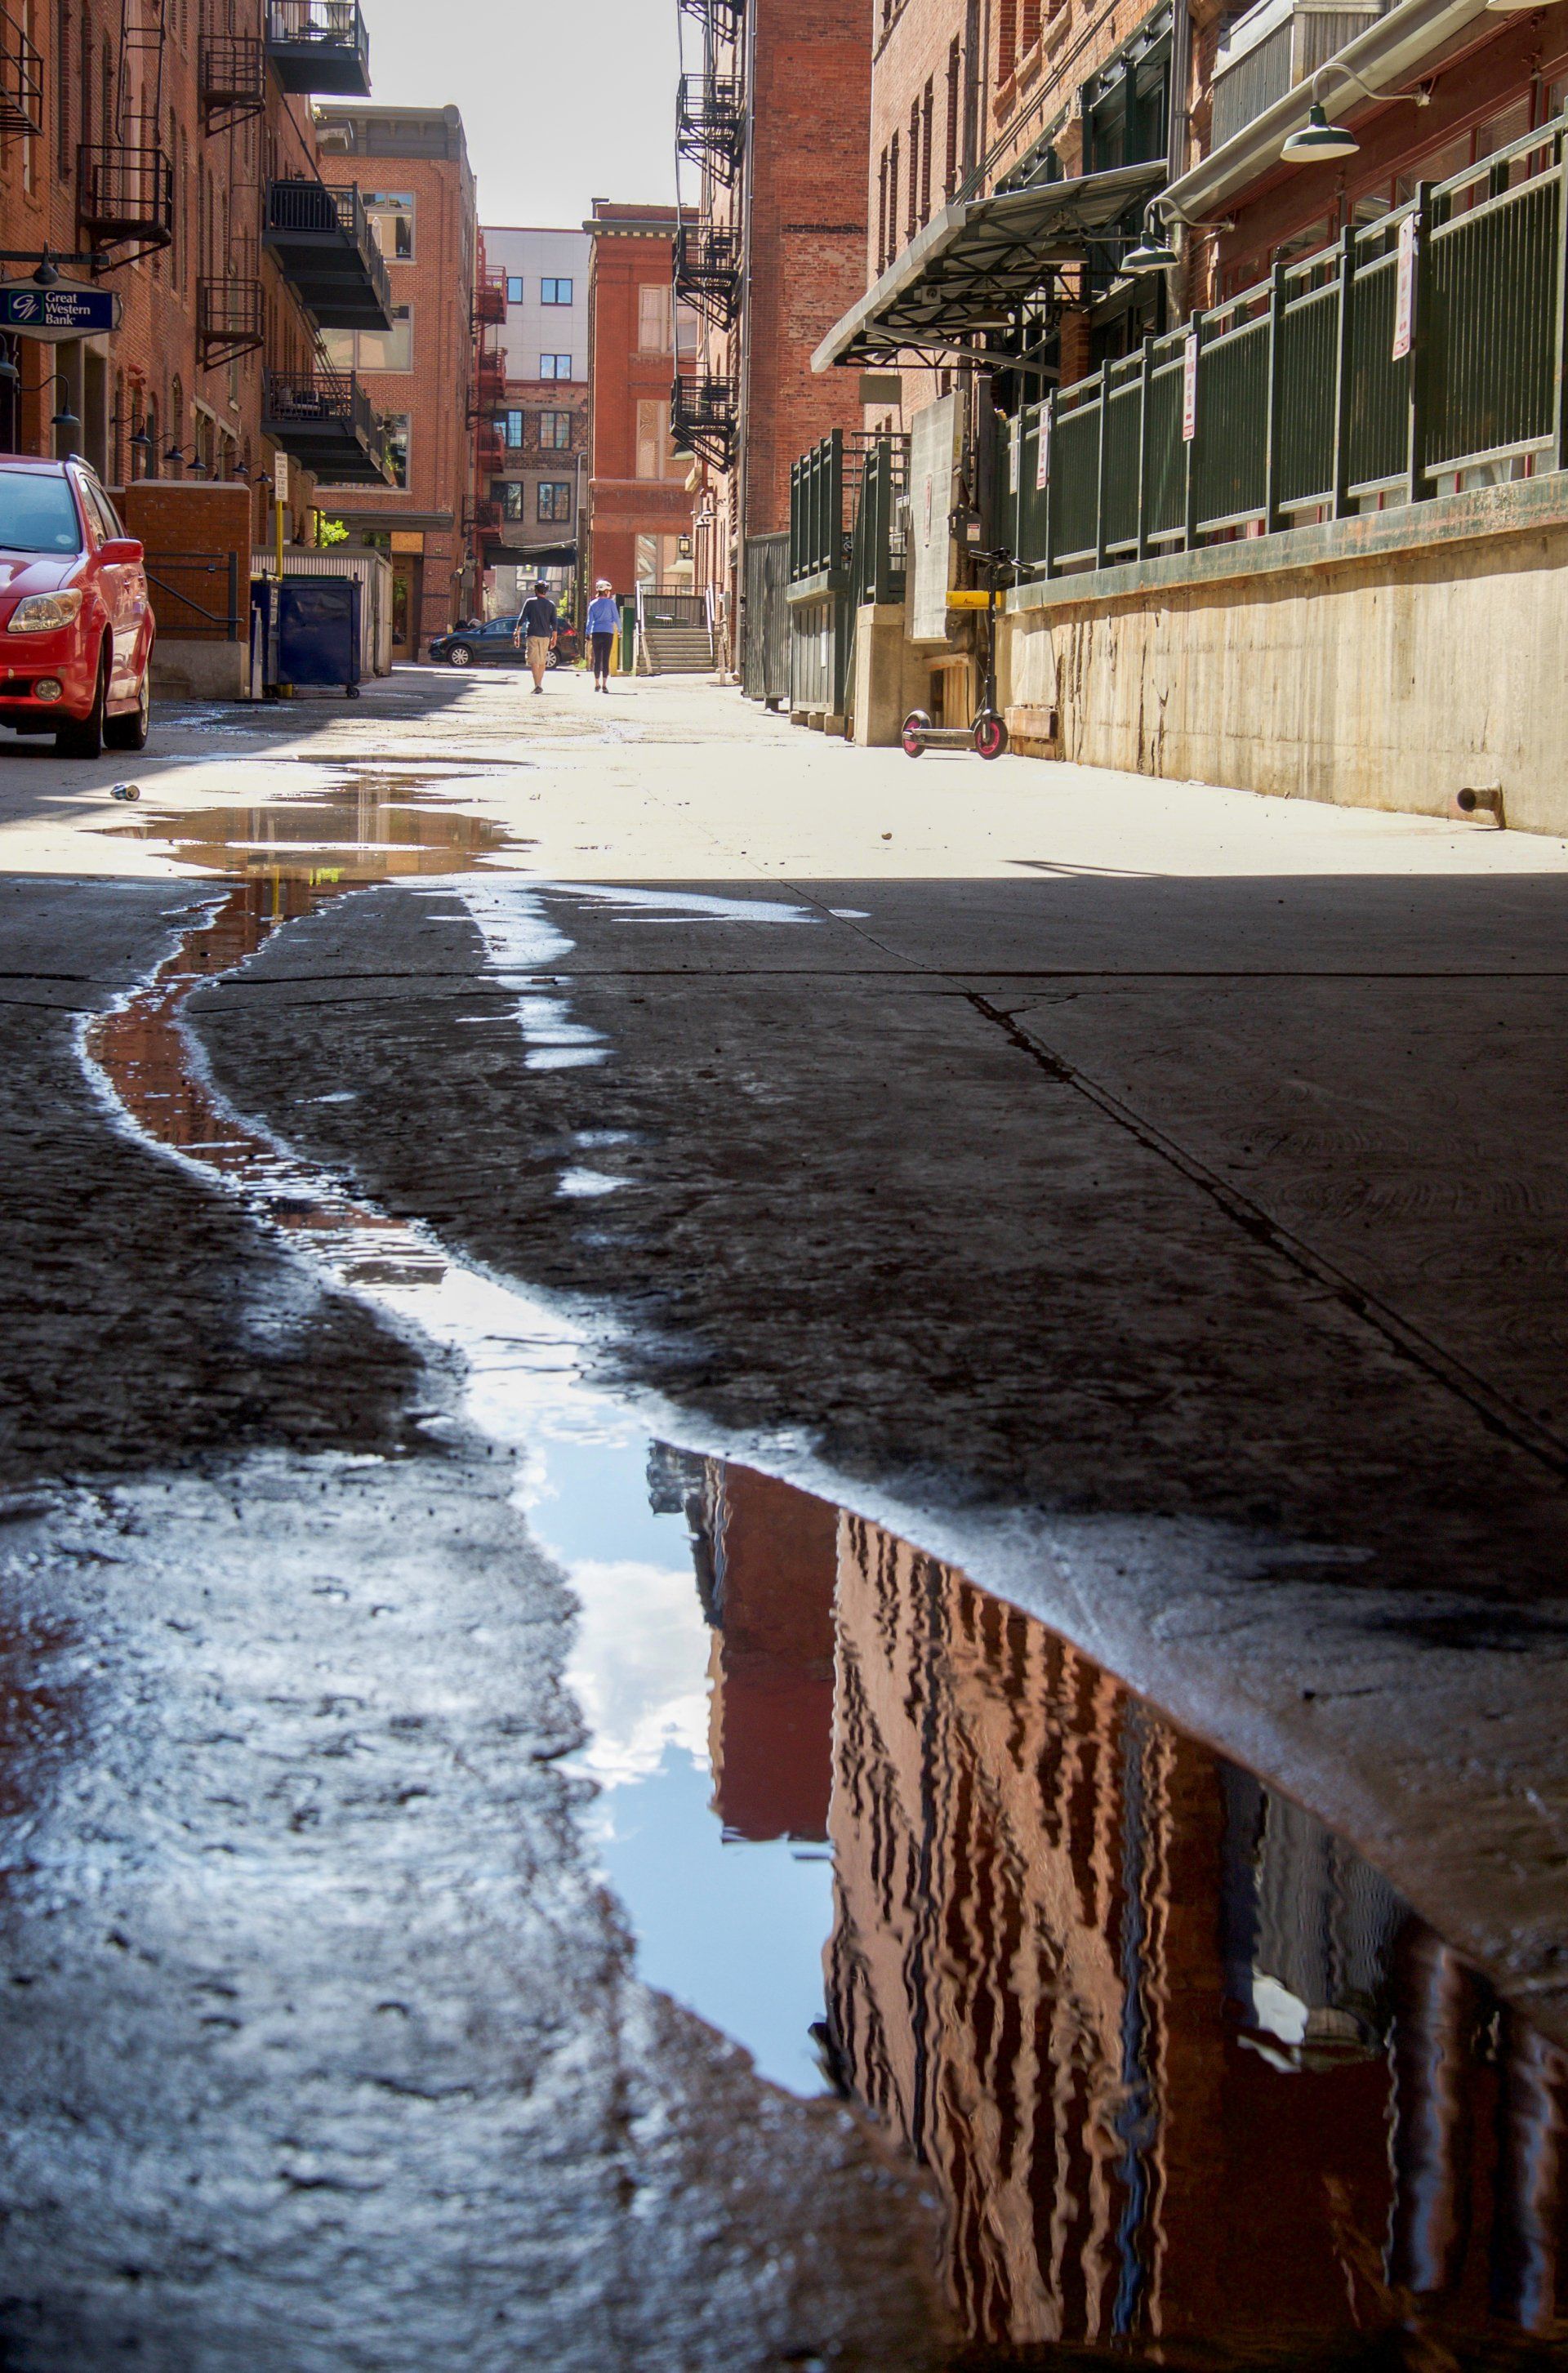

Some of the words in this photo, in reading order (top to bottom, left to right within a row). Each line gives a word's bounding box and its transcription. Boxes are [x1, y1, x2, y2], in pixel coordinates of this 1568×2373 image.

[46, 292, 78, 303] Great
[46, 303, 91, 314] Western
[46, 314, 74, 325] Bank
